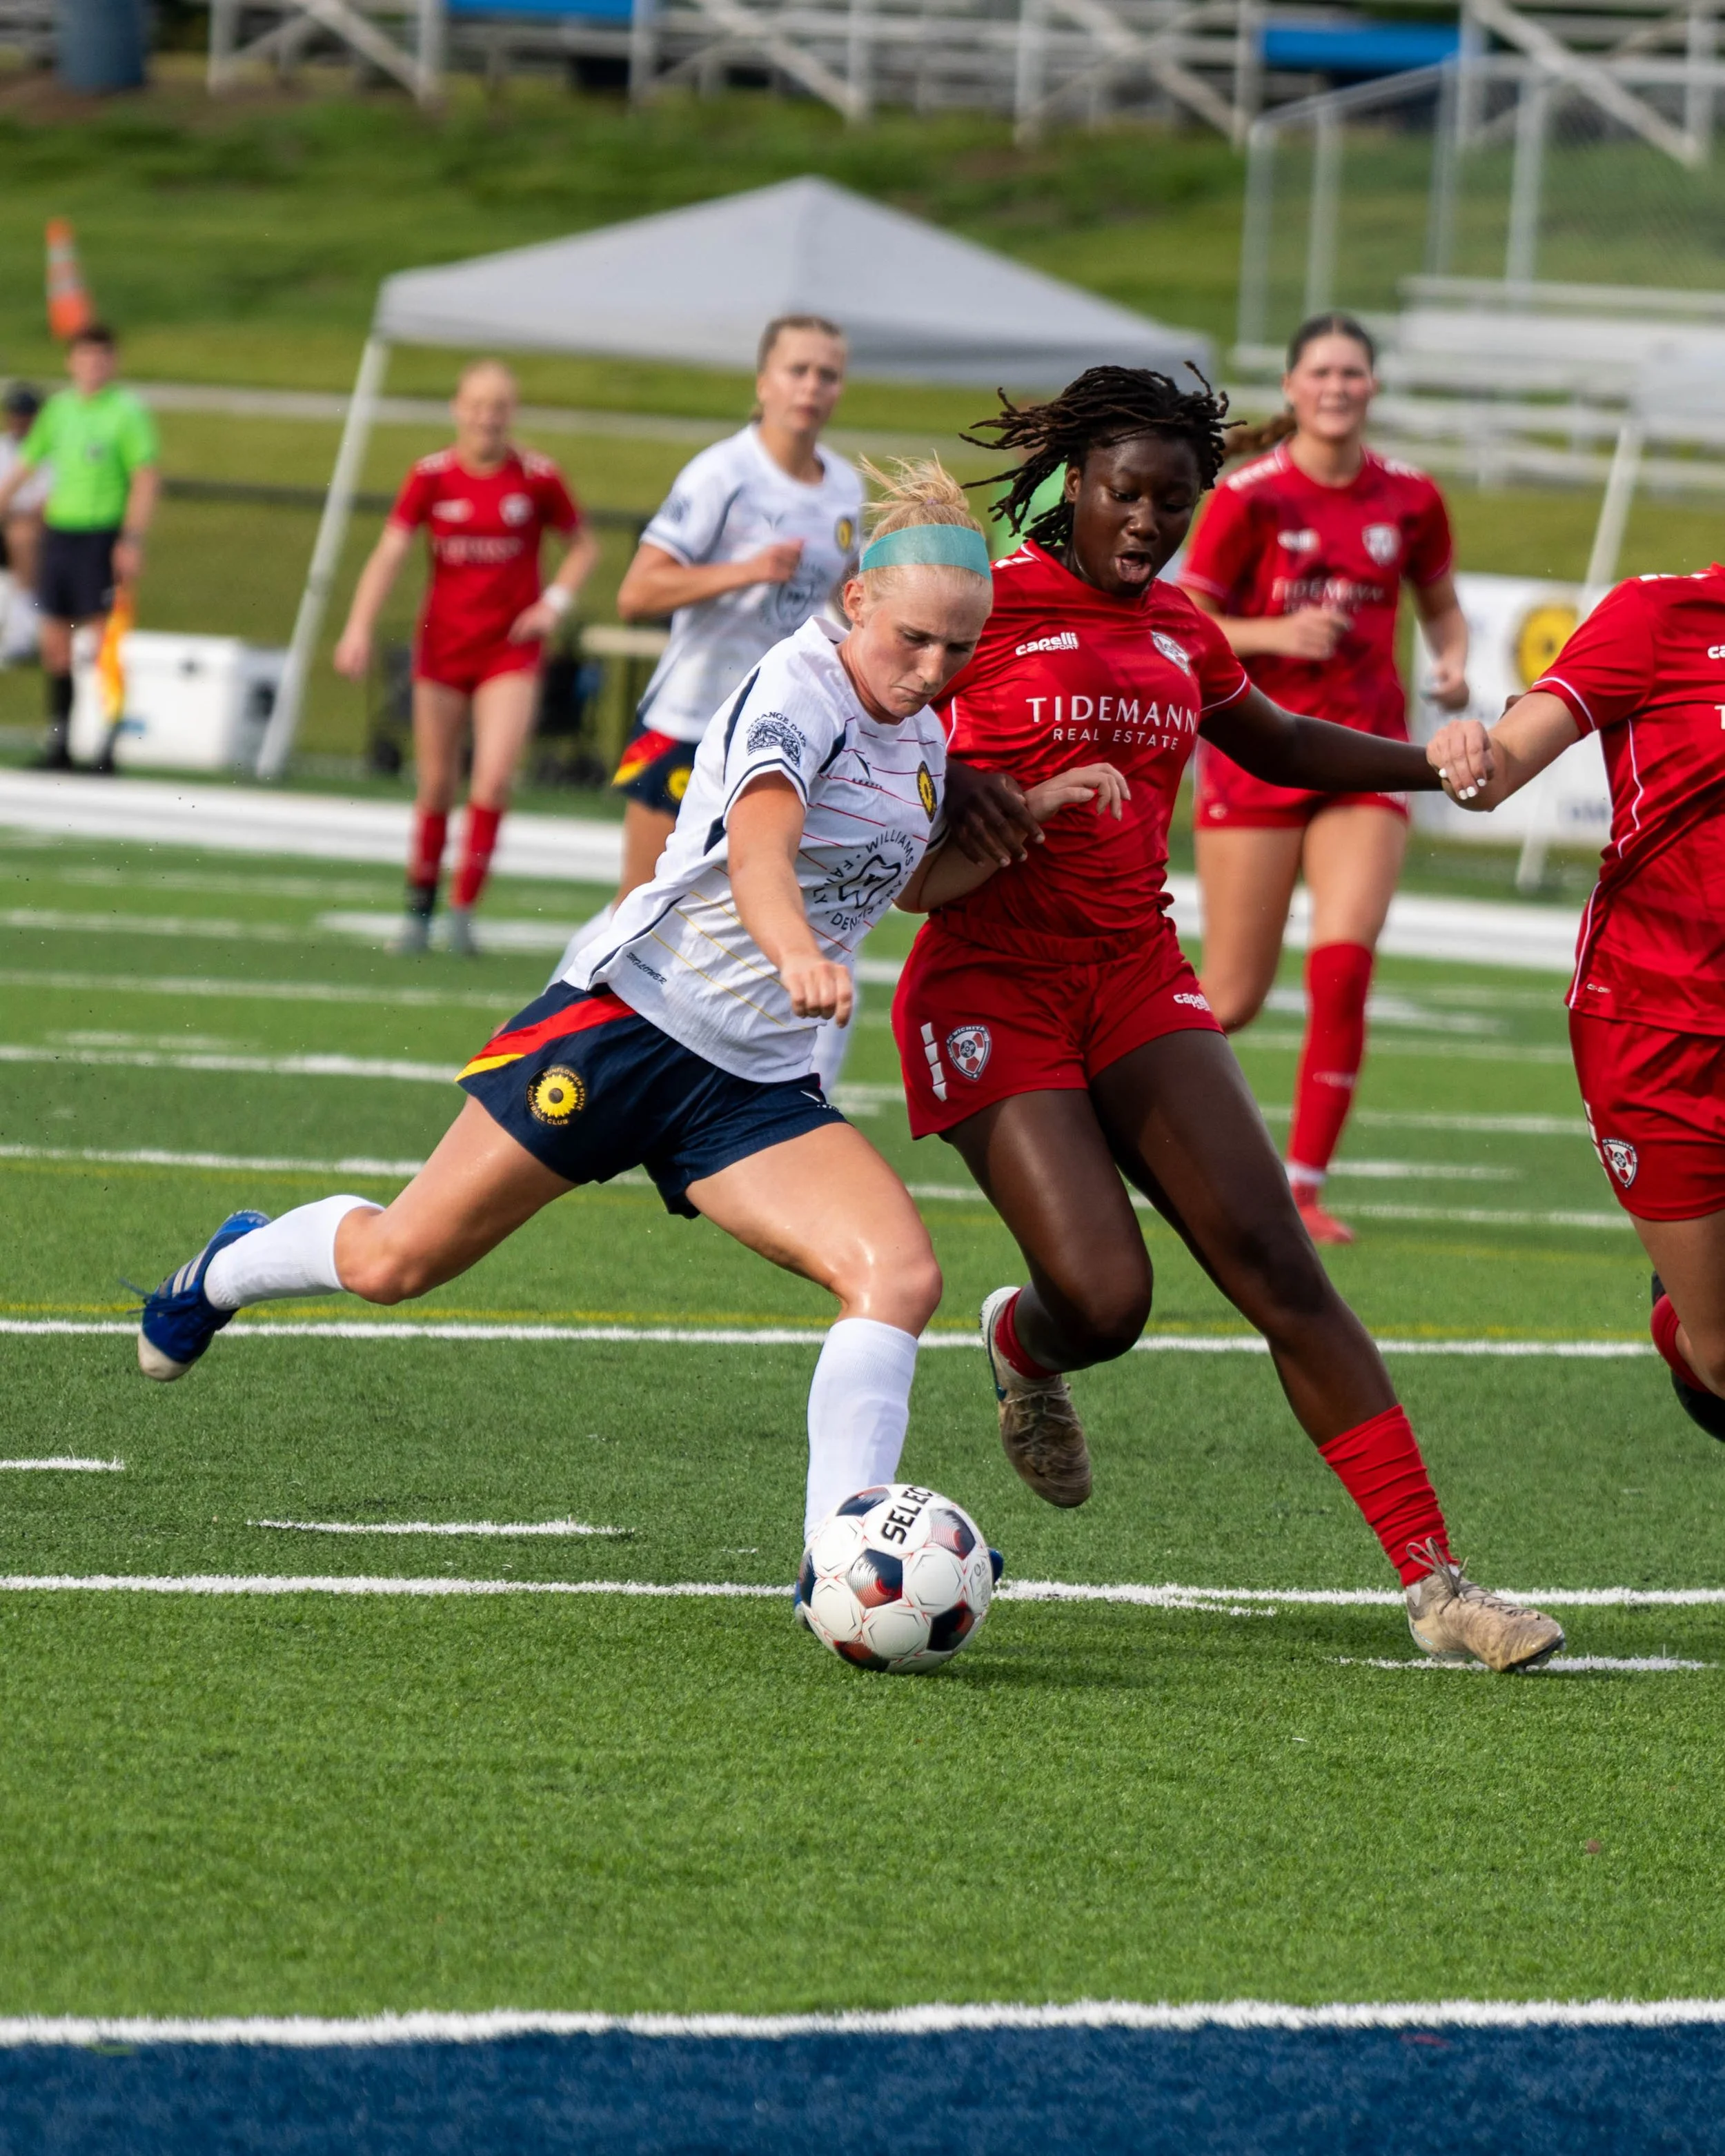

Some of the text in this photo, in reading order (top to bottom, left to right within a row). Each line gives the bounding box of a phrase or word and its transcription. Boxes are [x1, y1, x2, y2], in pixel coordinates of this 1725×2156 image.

[1016, 632, 1078, 655] capelli
[1025, 695, 1197, 736] TIDEMANN
[1053, 728, 1179, 751] REAL ESTATE
[865, 829, 914, 867] WILLIAMS
[952, 1026, 985, 1036] WICHITA
[527, 1085, 546, 1122] FOOTBALL
[542, 1067, 586, 1111] SUNFLOWER STATE
